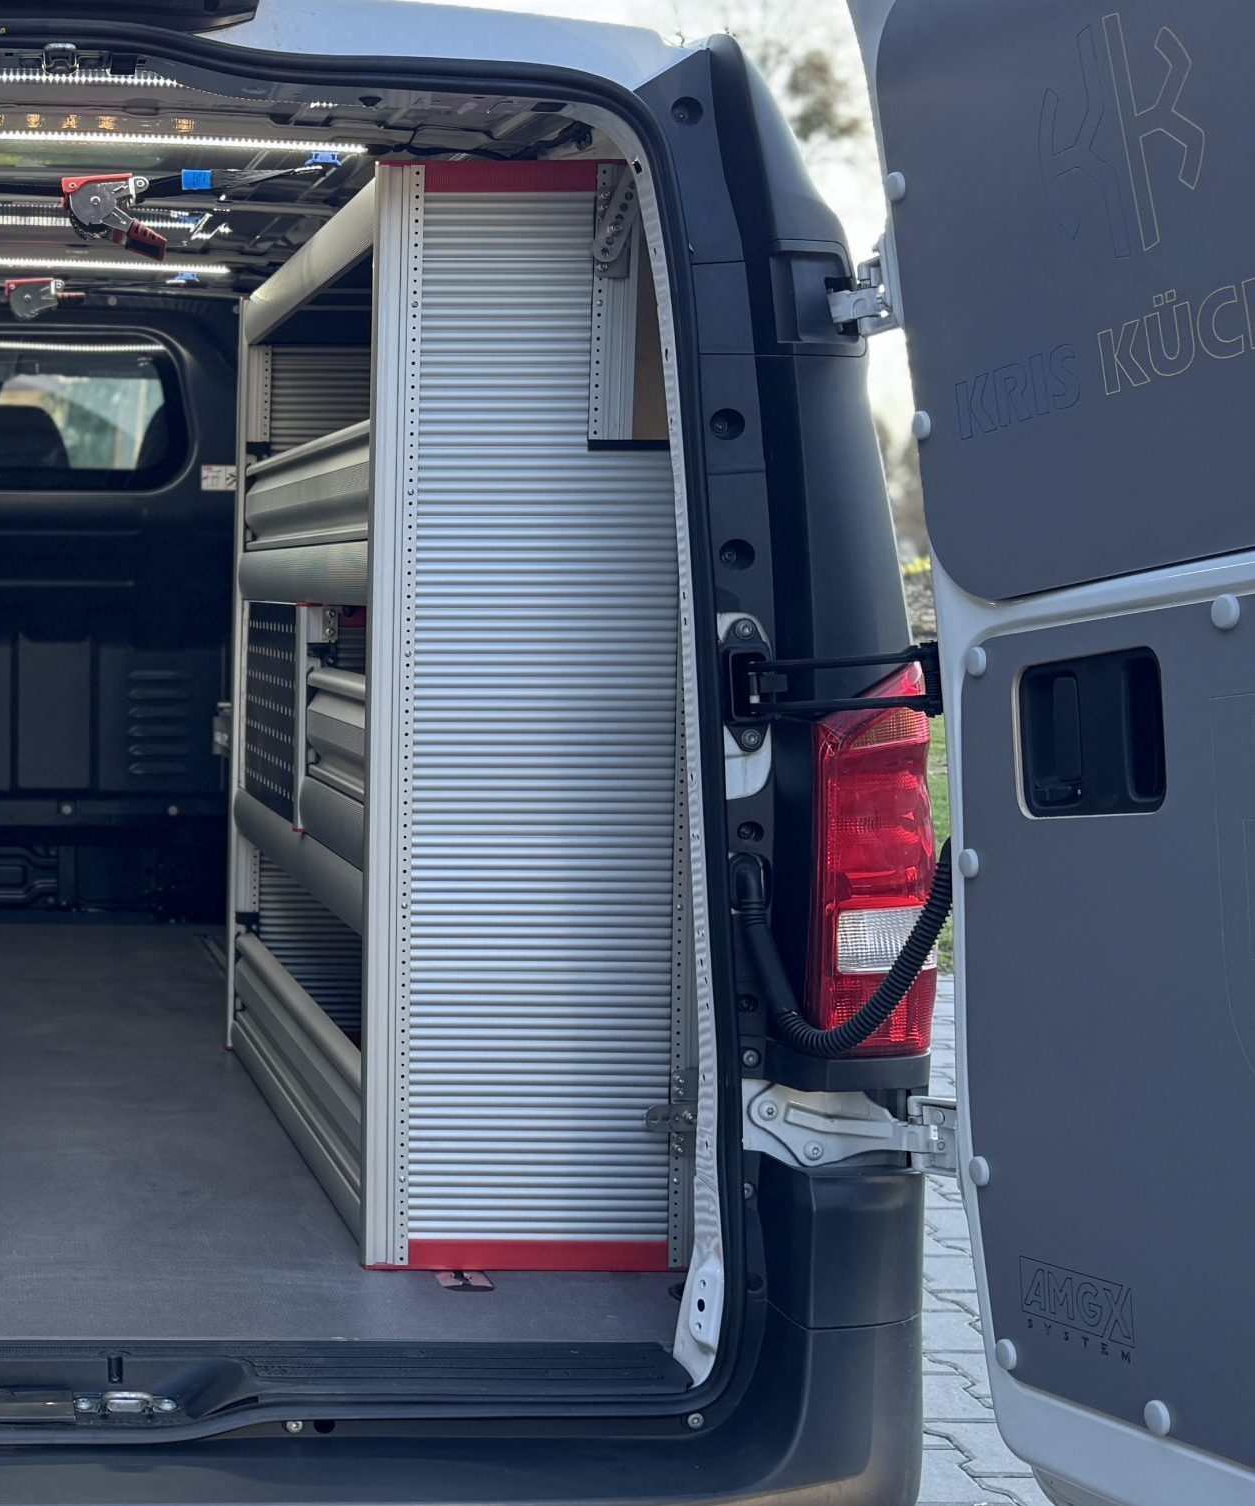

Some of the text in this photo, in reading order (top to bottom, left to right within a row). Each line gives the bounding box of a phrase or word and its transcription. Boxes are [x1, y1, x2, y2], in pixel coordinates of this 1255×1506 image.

[954, 343, 1081, 441] KRIS
[1024, 1267, 1134, 1345] AMGX
[1026, 1318, 1132, 1364] SYSTEM
